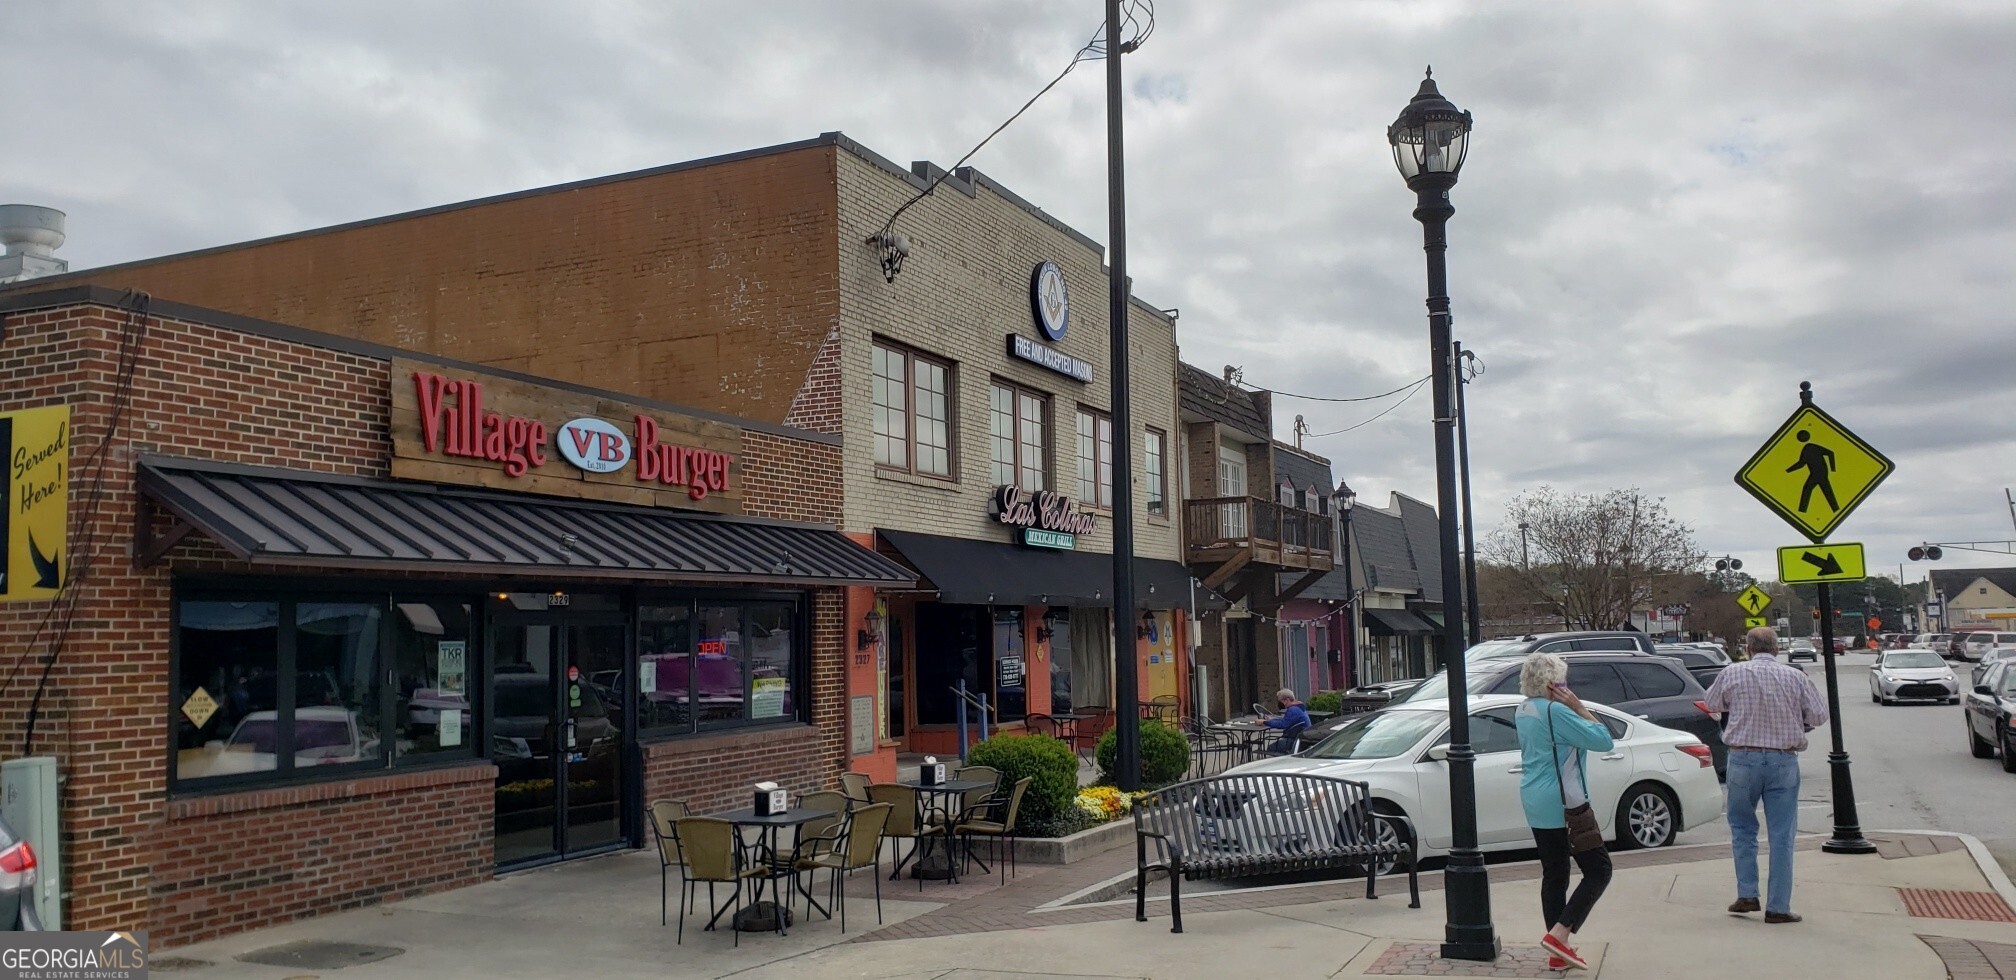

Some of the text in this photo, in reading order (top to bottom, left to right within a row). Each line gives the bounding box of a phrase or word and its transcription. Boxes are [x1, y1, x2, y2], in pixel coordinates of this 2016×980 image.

[1015, 337, 1093, 382] FREE AND ACCEPTED MASONS
[412, 372, 548, 478] Village
[567, 427, 625, 462] VB
[14, 421, 65, 480] Served
[635, 414, 734, 500] Burger
[21, 463, 61, 514] Here!
[1000, 484, 1097, 535] Las Colinas
[1028, 531, 1073, 547] MEXICAN GRILL
[550, 595, 568, 605] 2329
[441, 648, 462, 660] TKR
[698, 641, 727, 655] OPEN
[855, 655, 871, 665] 2327
